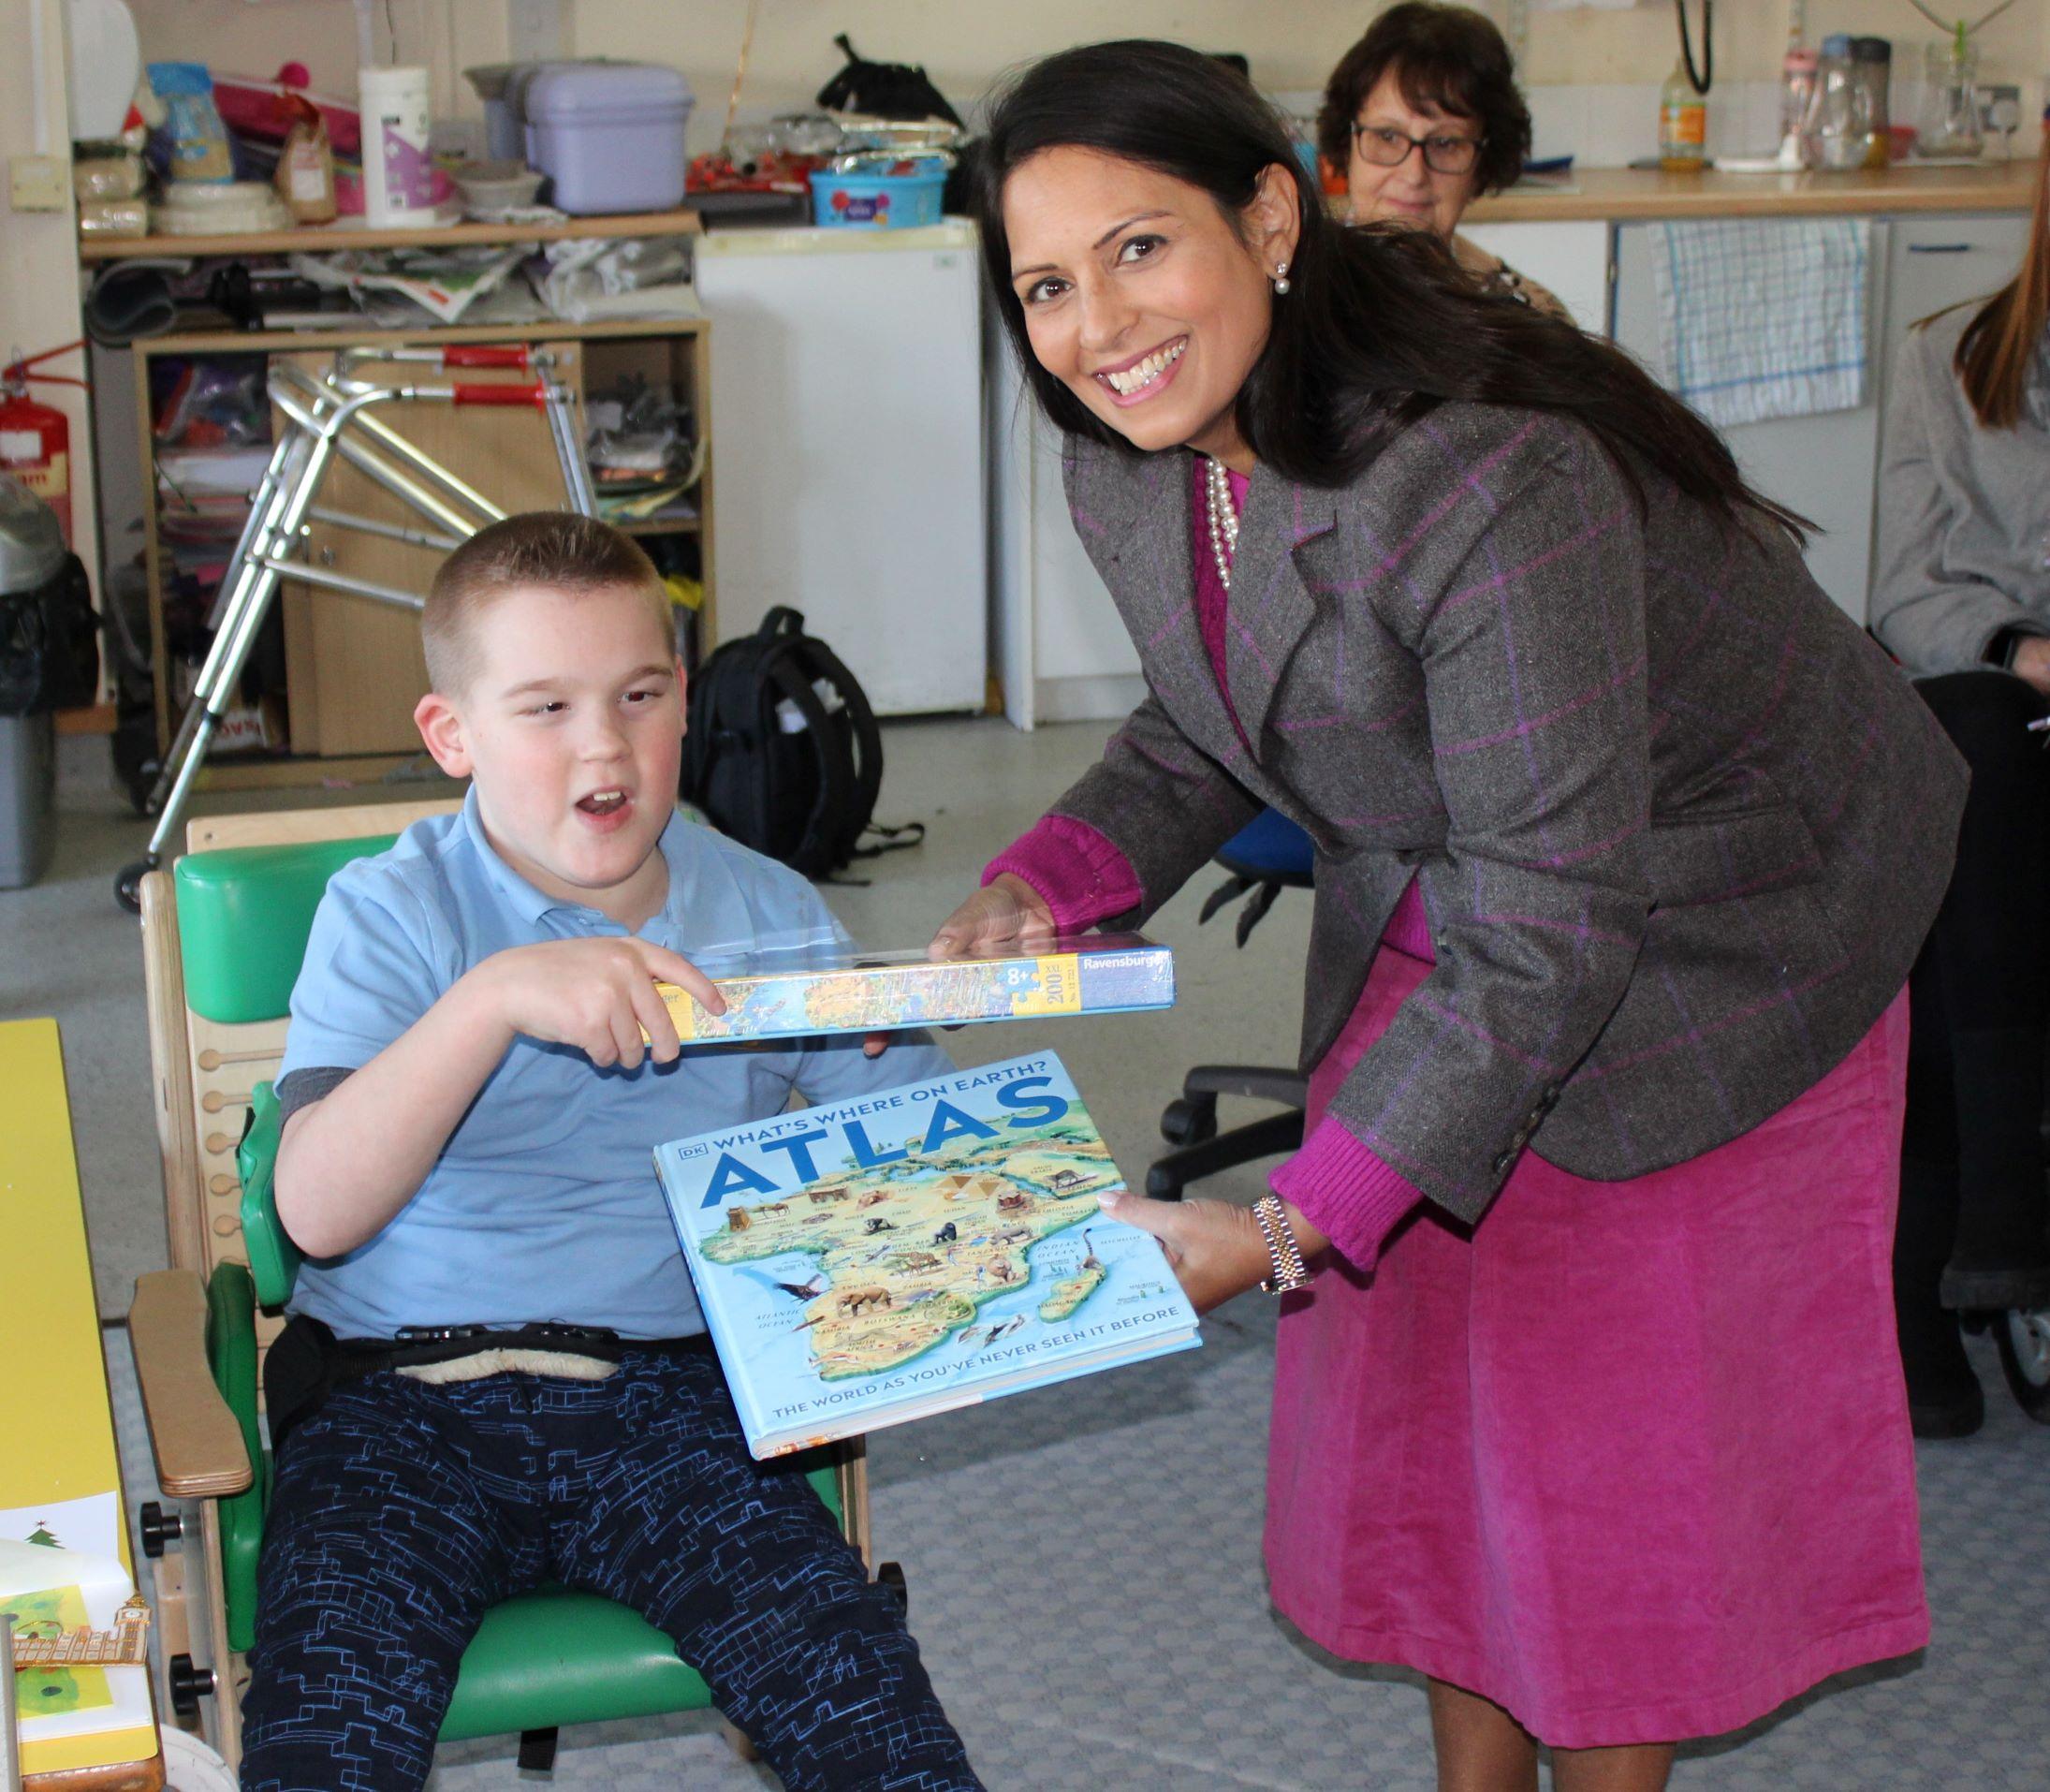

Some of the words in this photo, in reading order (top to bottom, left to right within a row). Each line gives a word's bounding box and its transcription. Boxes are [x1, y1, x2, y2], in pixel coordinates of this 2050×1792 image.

[1007, 966, 1029, 985] 8+
[1045, 964, 1062, 974] XXL
[1046, 974, 1063, 1005] 200
[713, 1119, 809, 1150] WHAT'S
[814, 1094, 904, 1124] WHERE
[910, 1084, 948, 1103] ON
[955, 1060, 1047, 1092] EARTH?
[682, 1146, 704, 1157] DK
[699, 1076, 1069, 1210] ATLAS
[772, 1402, 809, 1418] THE
[811, 1384, 879, 1410] WORLD
[883, 1378, 905, 1391] AS
[909, 1357, 976, 1383] YOU'VE
[980, 1344, 1038, 1365] NEVER
[1042, 1329, 1087, 1348] SEEN
[1091, 1324, 1106, 1337] IT
[1111, 1305, 1180, 1332] BEFORE
